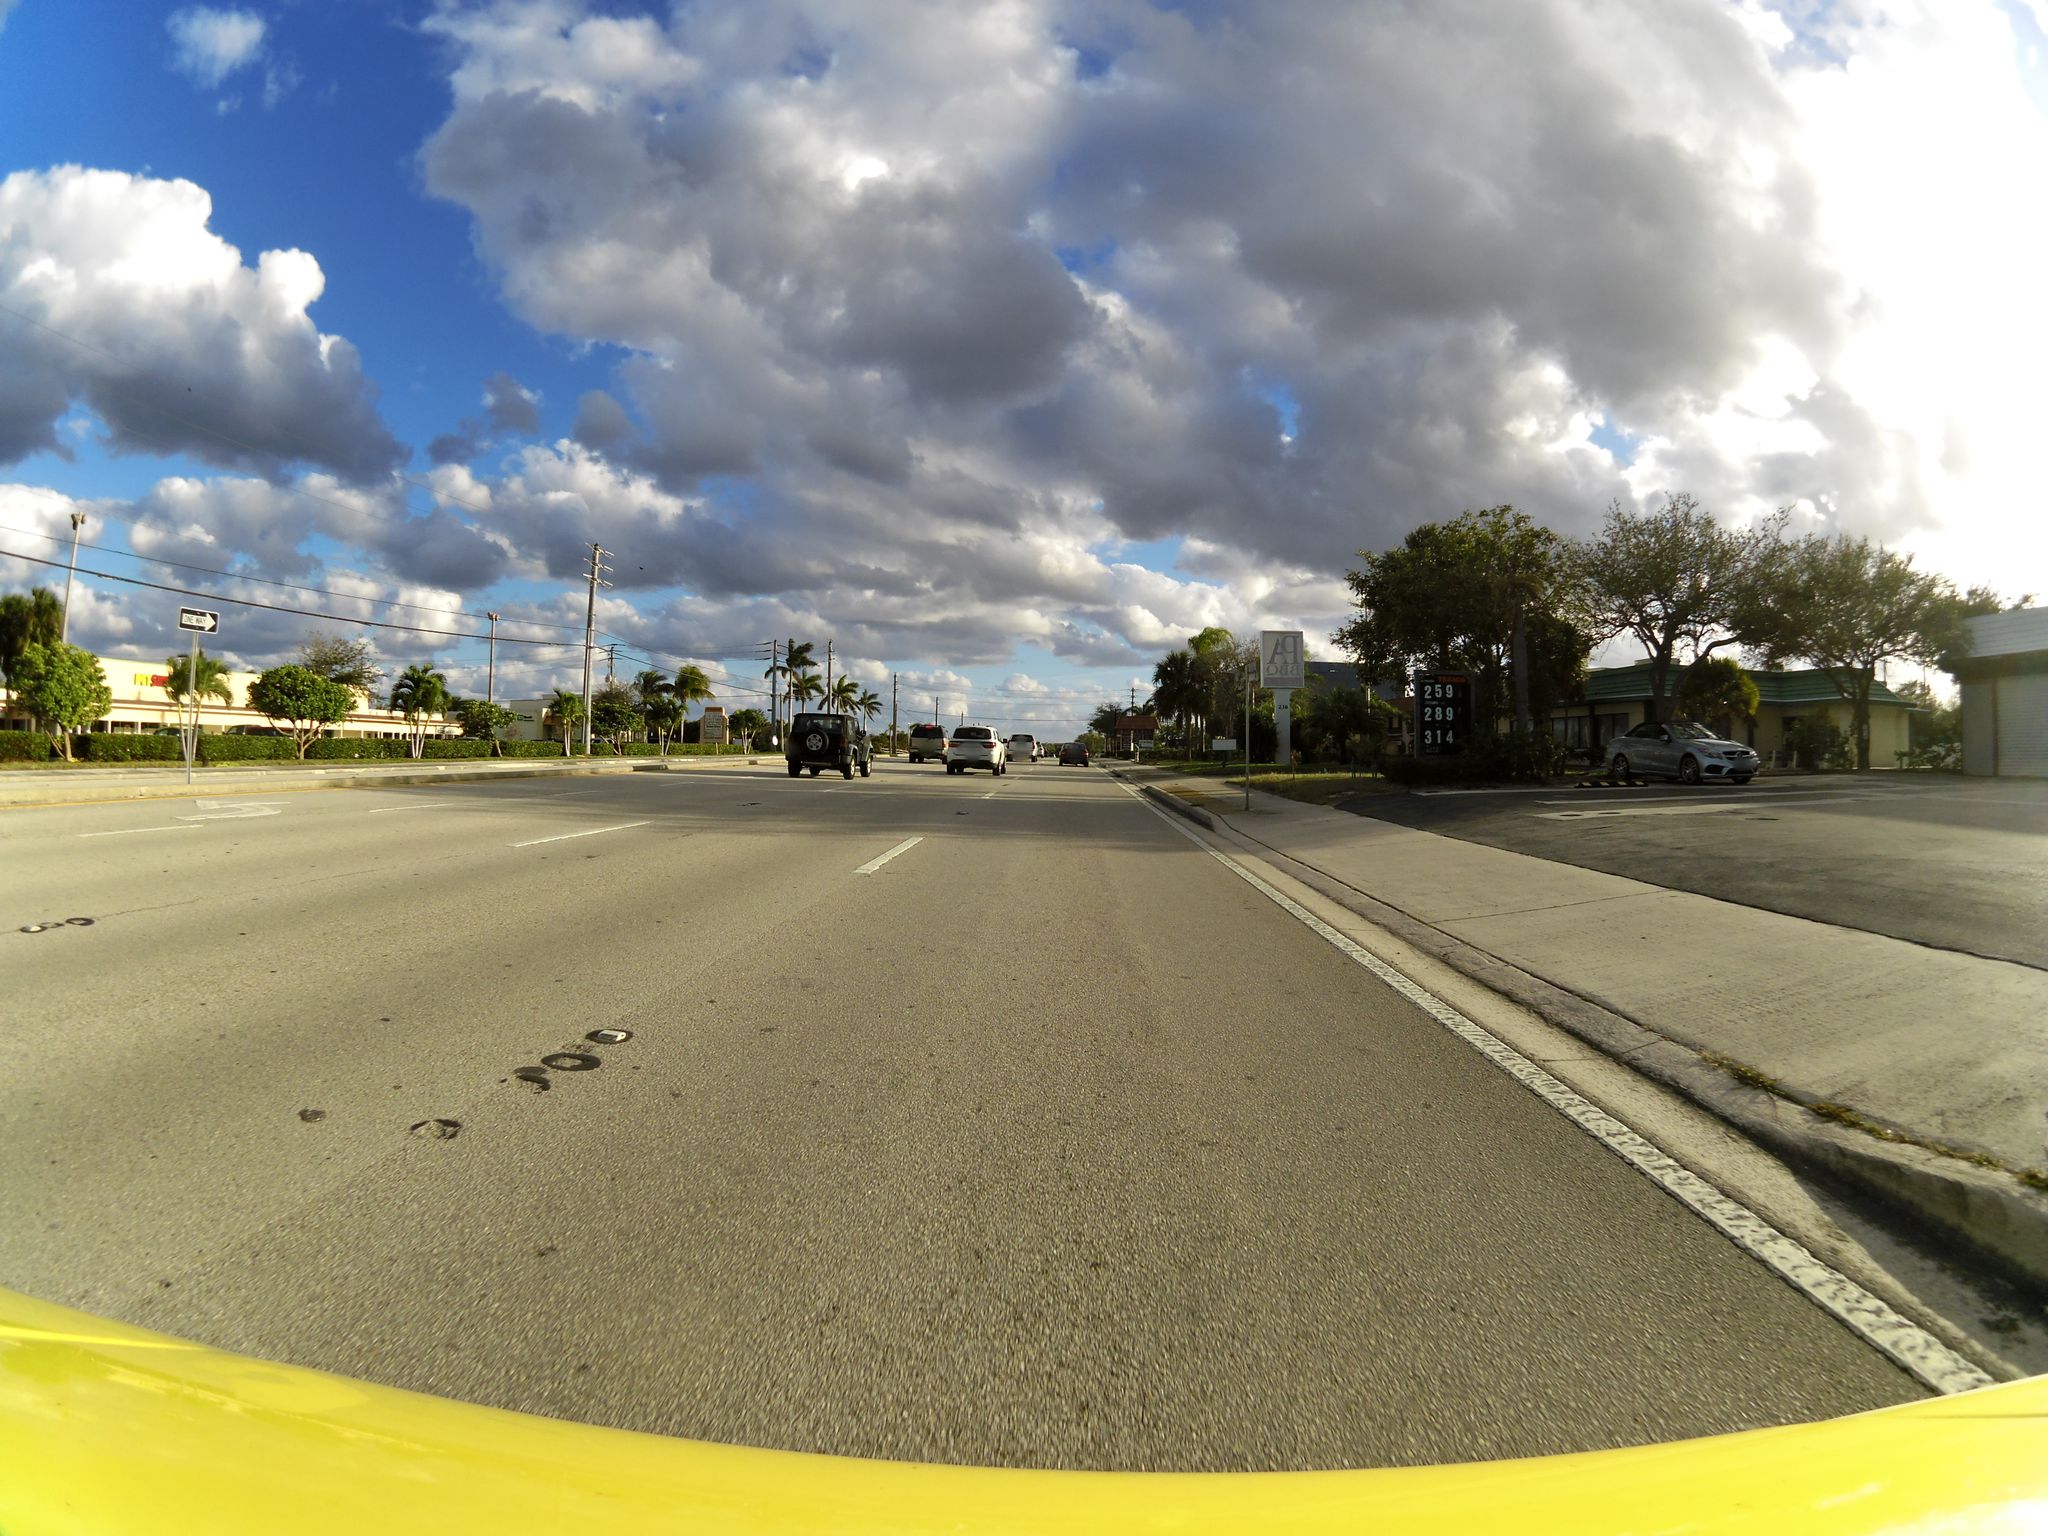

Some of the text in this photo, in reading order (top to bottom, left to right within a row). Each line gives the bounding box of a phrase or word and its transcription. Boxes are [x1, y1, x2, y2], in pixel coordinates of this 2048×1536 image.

[184, 615, 206, 625] ONE WAY
[1424, 684, 1453, 699] 259
[1424, 707, 1453, 721] 289
[1424, 729, 1454, 744] 314
